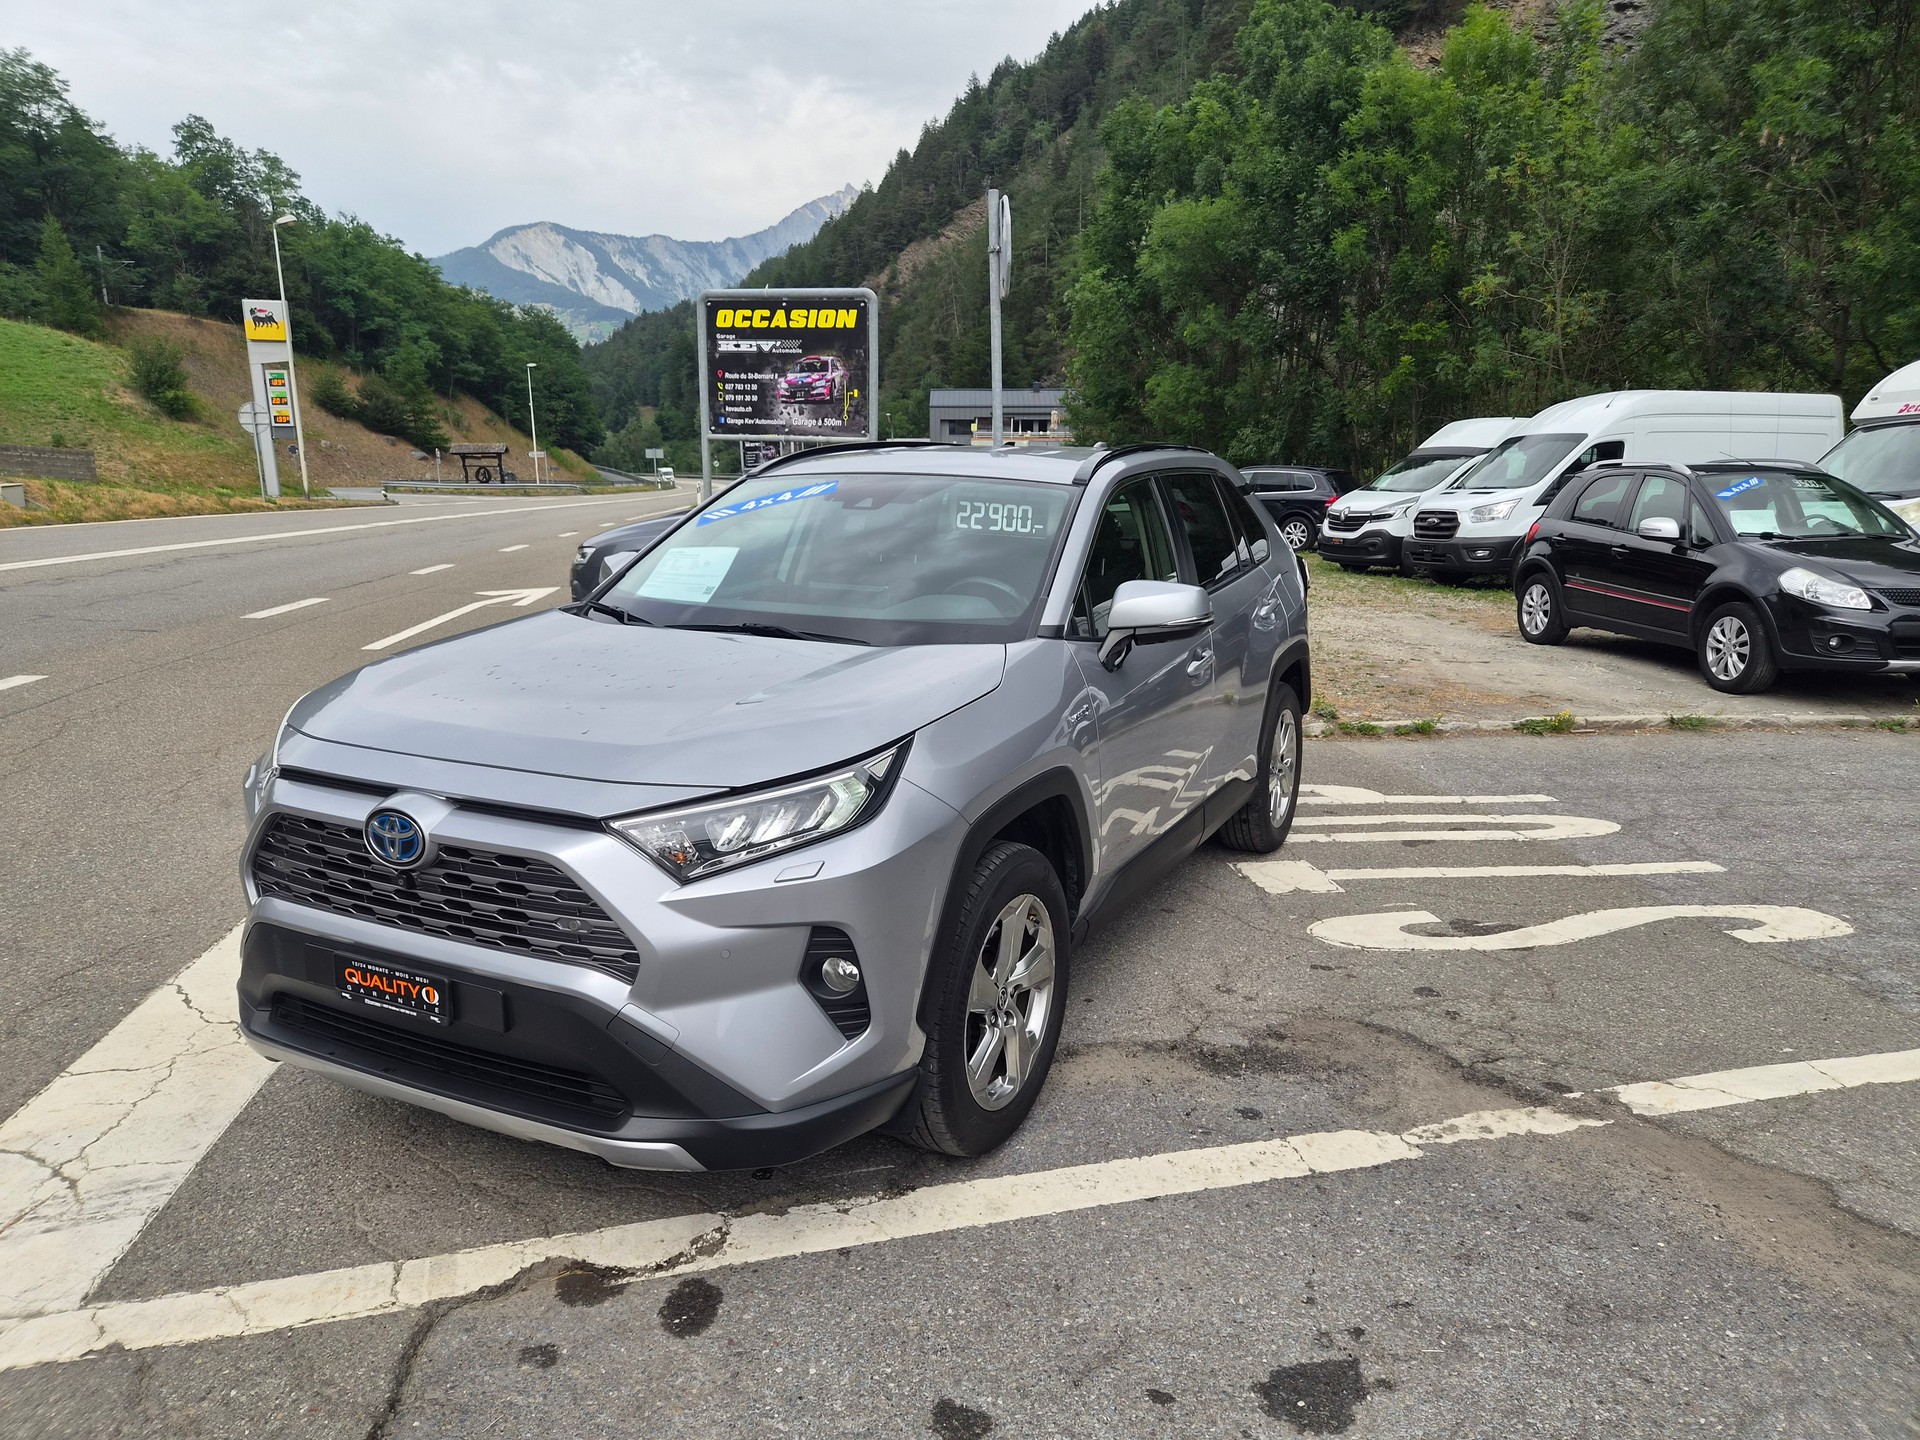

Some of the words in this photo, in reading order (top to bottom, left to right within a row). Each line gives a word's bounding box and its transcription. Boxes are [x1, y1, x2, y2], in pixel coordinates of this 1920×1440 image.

[715, 309, 858, 328] OCCASION
[724, 372, 740, 380] Route
[740, 372, 747, 380] du
[747, 372, 774, 380] St-Bernard
[726, 417, 744, 425] Garage
[792, 418, 816, 427] Garage
[823, 418, 842, 426] 500m
[344, 968, 420, 999] QUALITY
[367, 964, 389, 974] MONATE
[395, 971, 409, 979] MOIS
[415, 976, 429, 984] MESI
[346, 984, 440, 1014] GARANTIE
